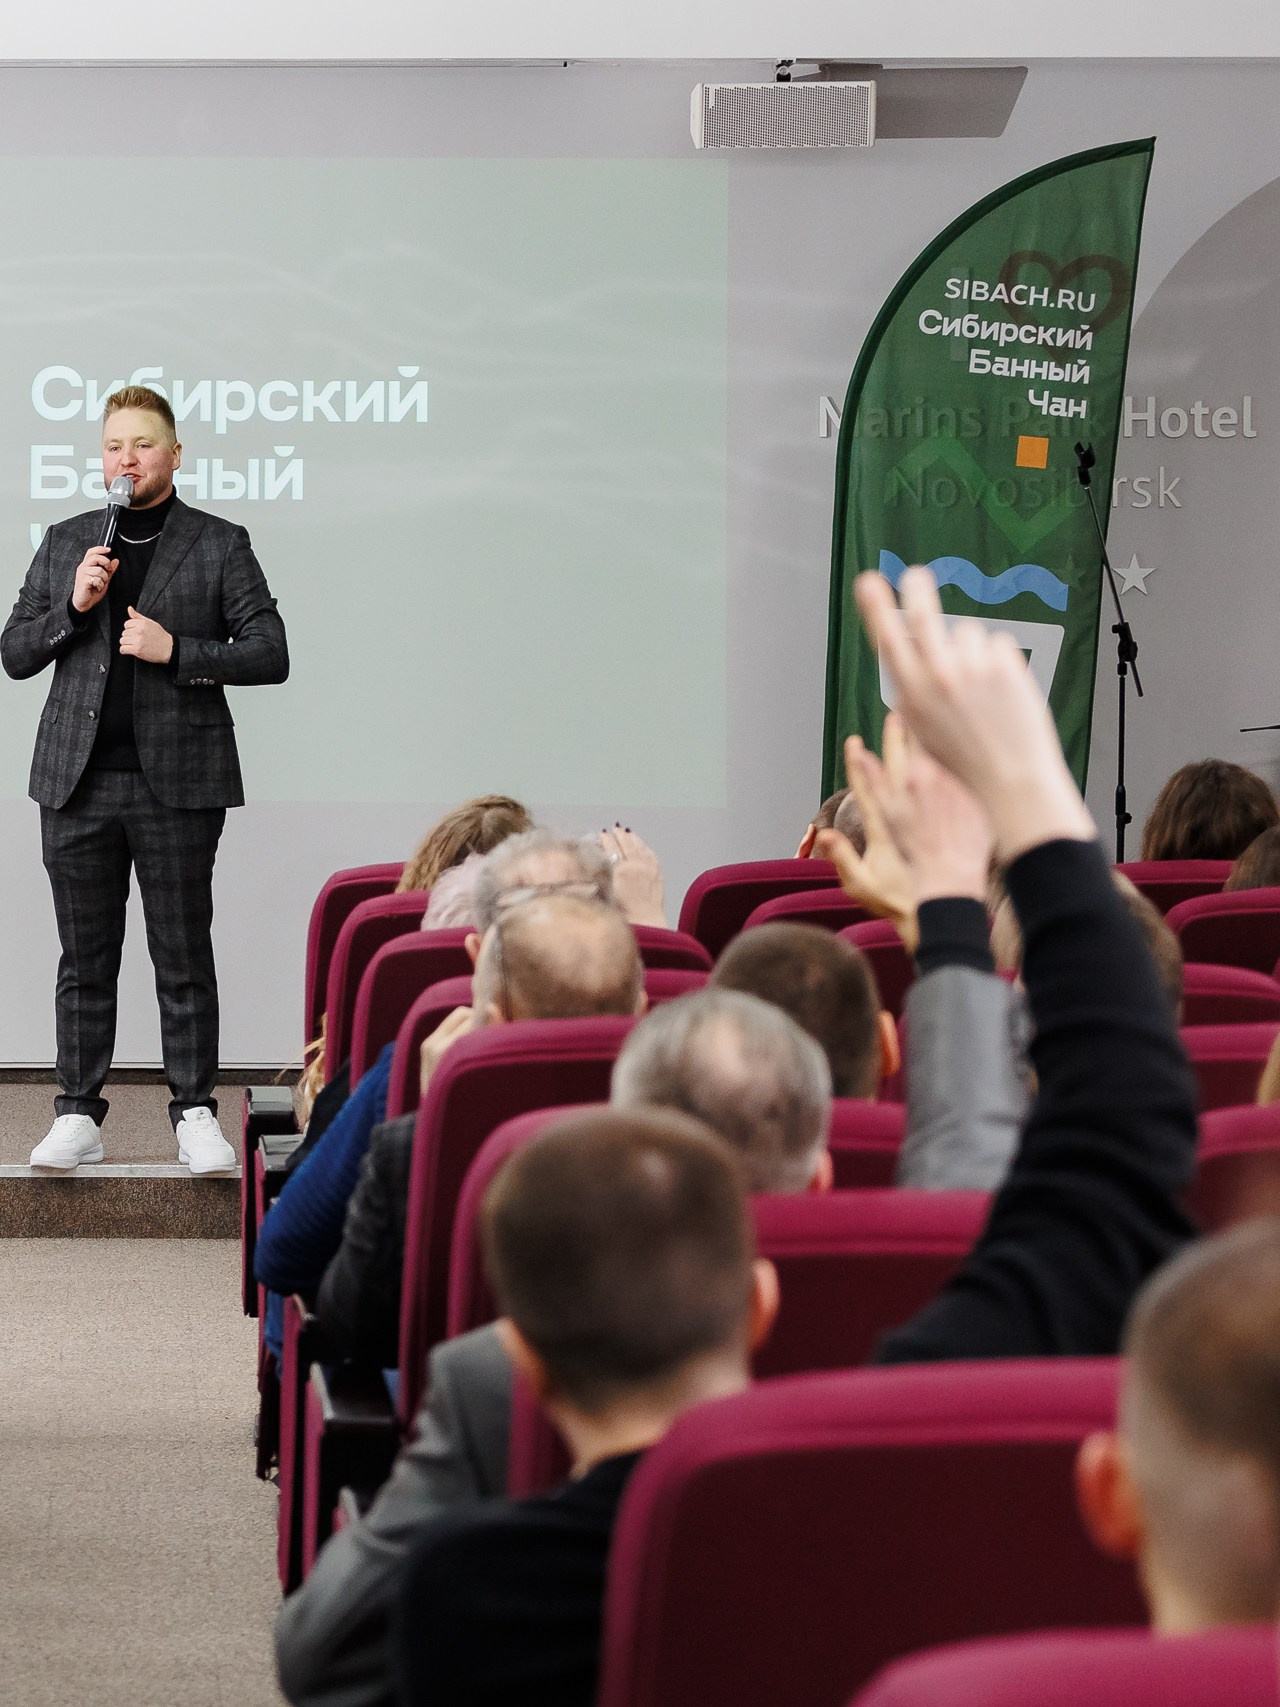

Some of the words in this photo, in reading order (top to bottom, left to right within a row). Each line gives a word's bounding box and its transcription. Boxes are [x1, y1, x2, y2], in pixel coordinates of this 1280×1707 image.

[944, 277, 1096, 313] SIBACH.RU
[918, 308, 1093, 351] Сибирский
[969, 348, 1091, 385] Банный
[1028, 388, 1087, 419] Чан
[1123, 395, 1258, 439] Hotel
[30, 444, 304, 500] Баный
